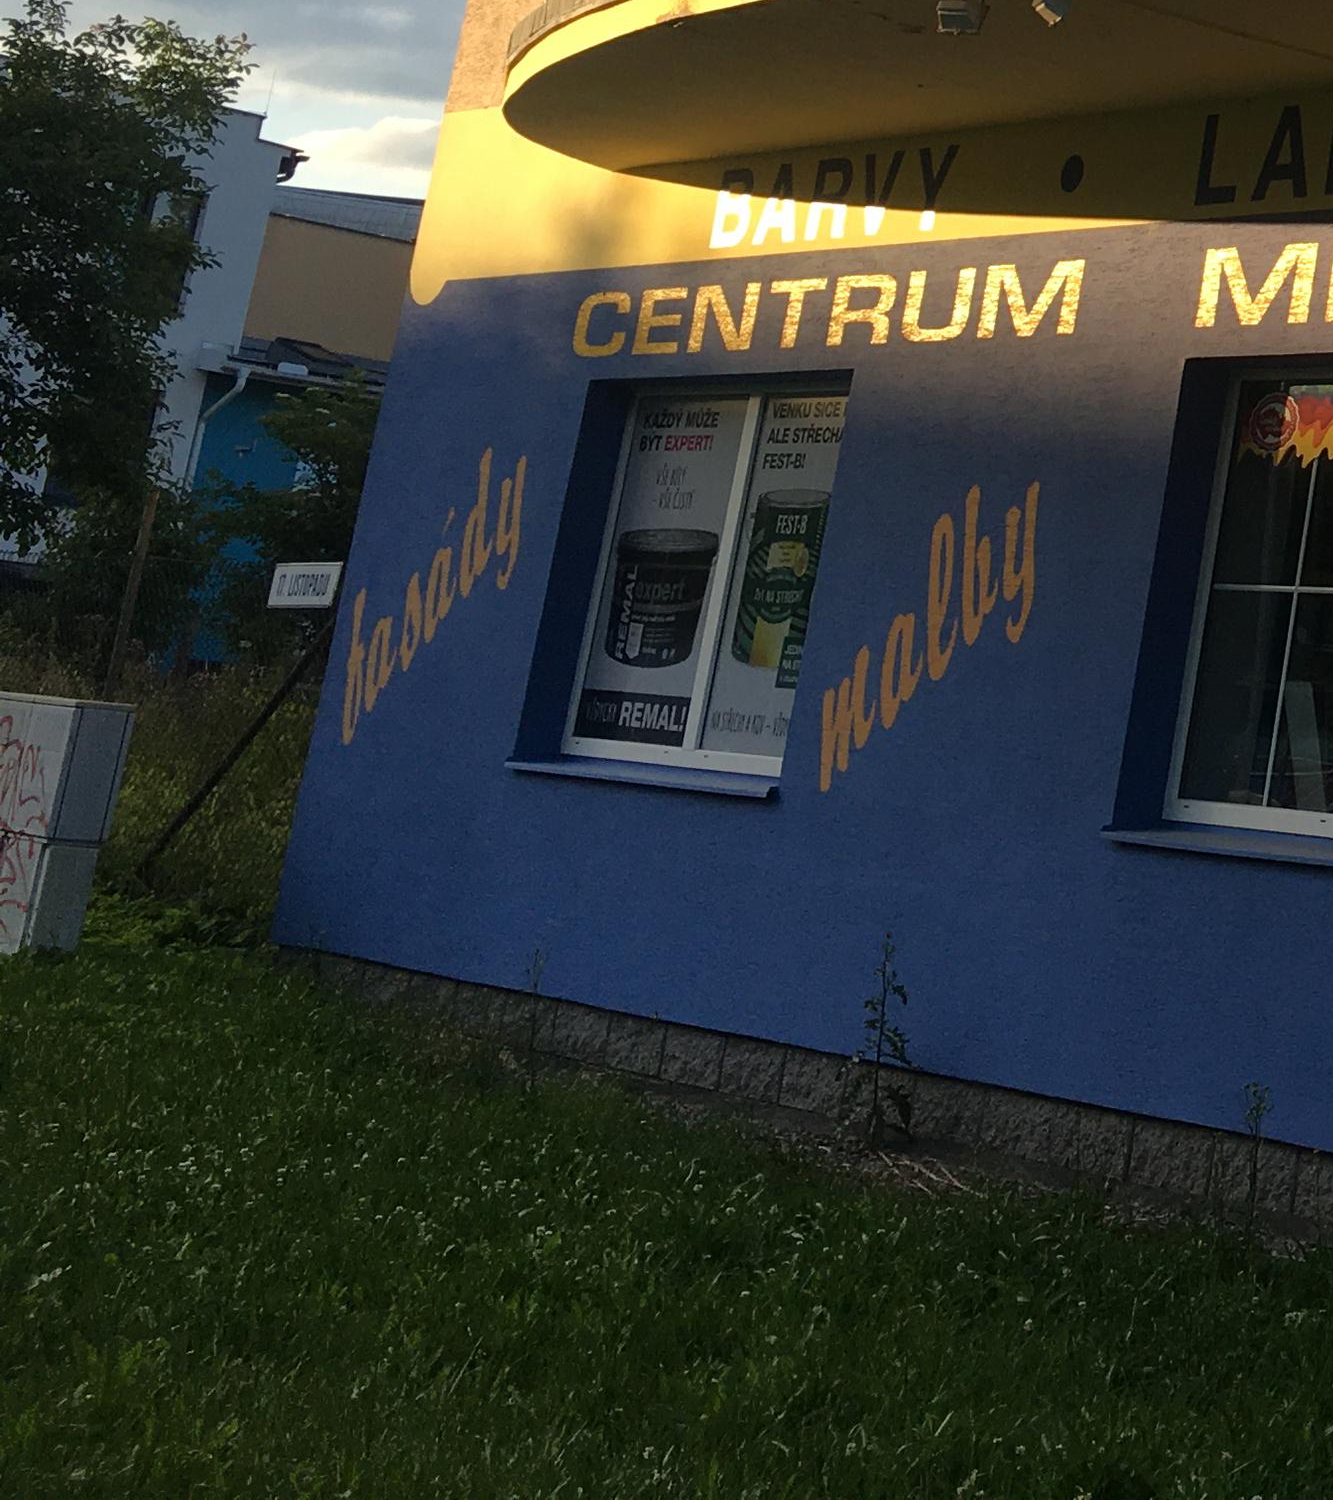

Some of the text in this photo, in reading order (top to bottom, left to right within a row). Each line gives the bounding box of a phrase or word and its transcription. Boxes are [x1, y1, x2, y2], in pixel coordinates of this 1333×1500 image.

[708, 144, 960, 249] BARVY
[572, 259, 1086, 358] CENTRUM
[643, 407, 720, 429] KAŽDÝ MŮŽE
[773, 402, 812, 419] VENKU
[813, 401, 841, 418] SICE
[639, 432, 713, 452] BÝT EXPERT!
[767, 427, 790, 444] ALE
[762, 453, 806, 470] FEST-B!
[775, 514, 808, 535] FEST-B
[341, 447, 527, 745] fasády
[614, 564, 639, 660] REMAL
[820, 480, 1040, 793] malby
[618, 701, 689, 733] REMAL!
